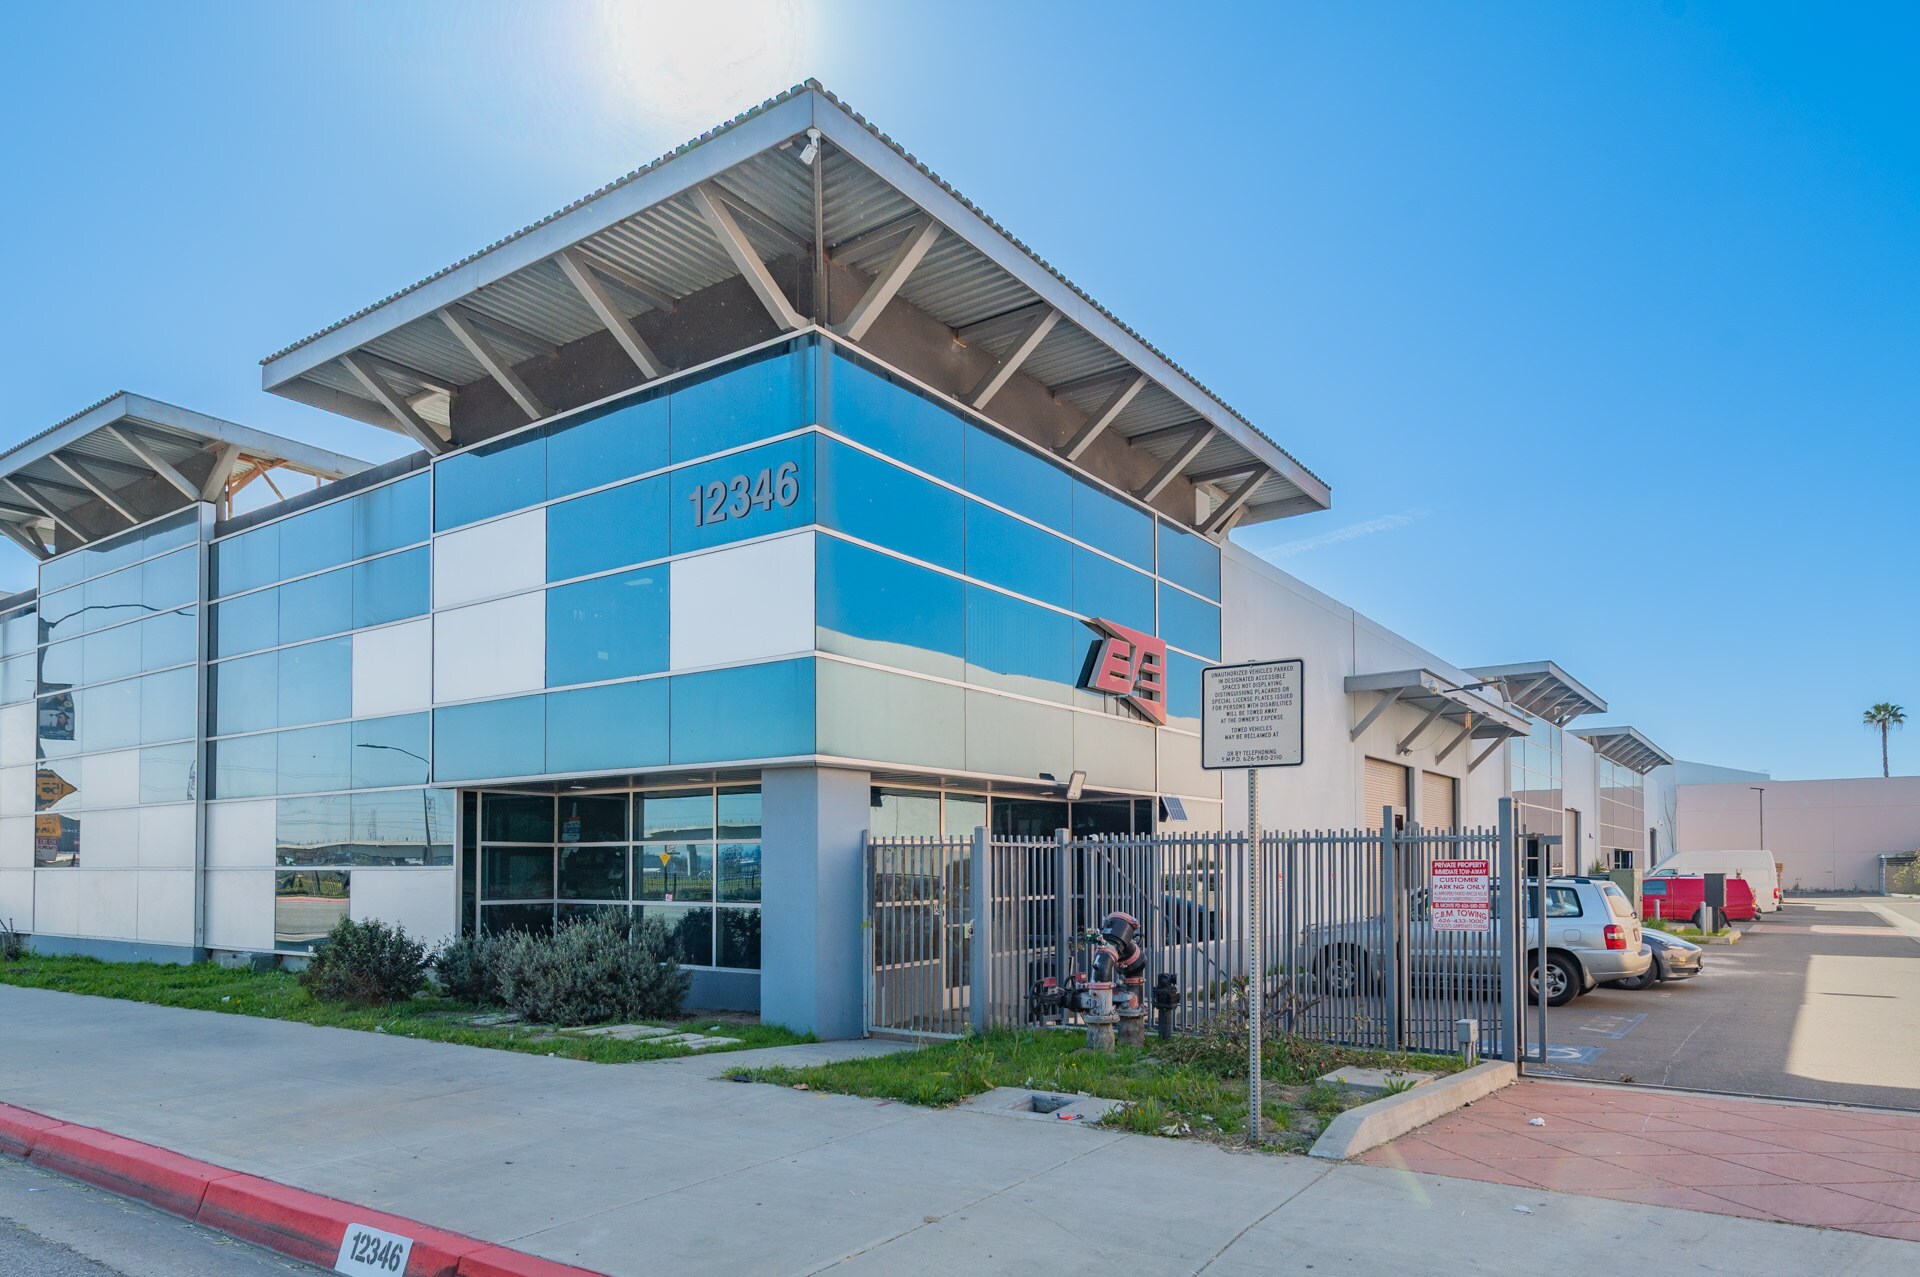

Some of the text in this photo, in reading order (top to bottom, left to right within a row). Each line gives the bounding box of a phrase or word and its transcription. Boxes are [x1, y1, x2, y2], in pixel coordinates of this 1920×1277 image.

[690, 461, 799, 527] 12346
[1211, 669, 1248, 678] UNAUTHORIZED
[1249, 667, 1273, 675] VEHICLES
[1224, 675, 1254, 683] DESIGNATED
[1255, 673, 1286, 681] ACCESSIBLE
[1252, 680, 1282, 688] DISPLAYING
[1215, 689, 1253, 698] DISTINGUISHING
[1254, 687, 1281, 695] PLACARDS
[1212, 697, 1231, 705] SPECIAL
[1260, 700, 1293, 708] DISABILITIES
[1238, 715, 1259, 723] OWNER'S
[1457, 910, 1487, 920] TOWING
[350, 1231, 404, 1272] 12346
